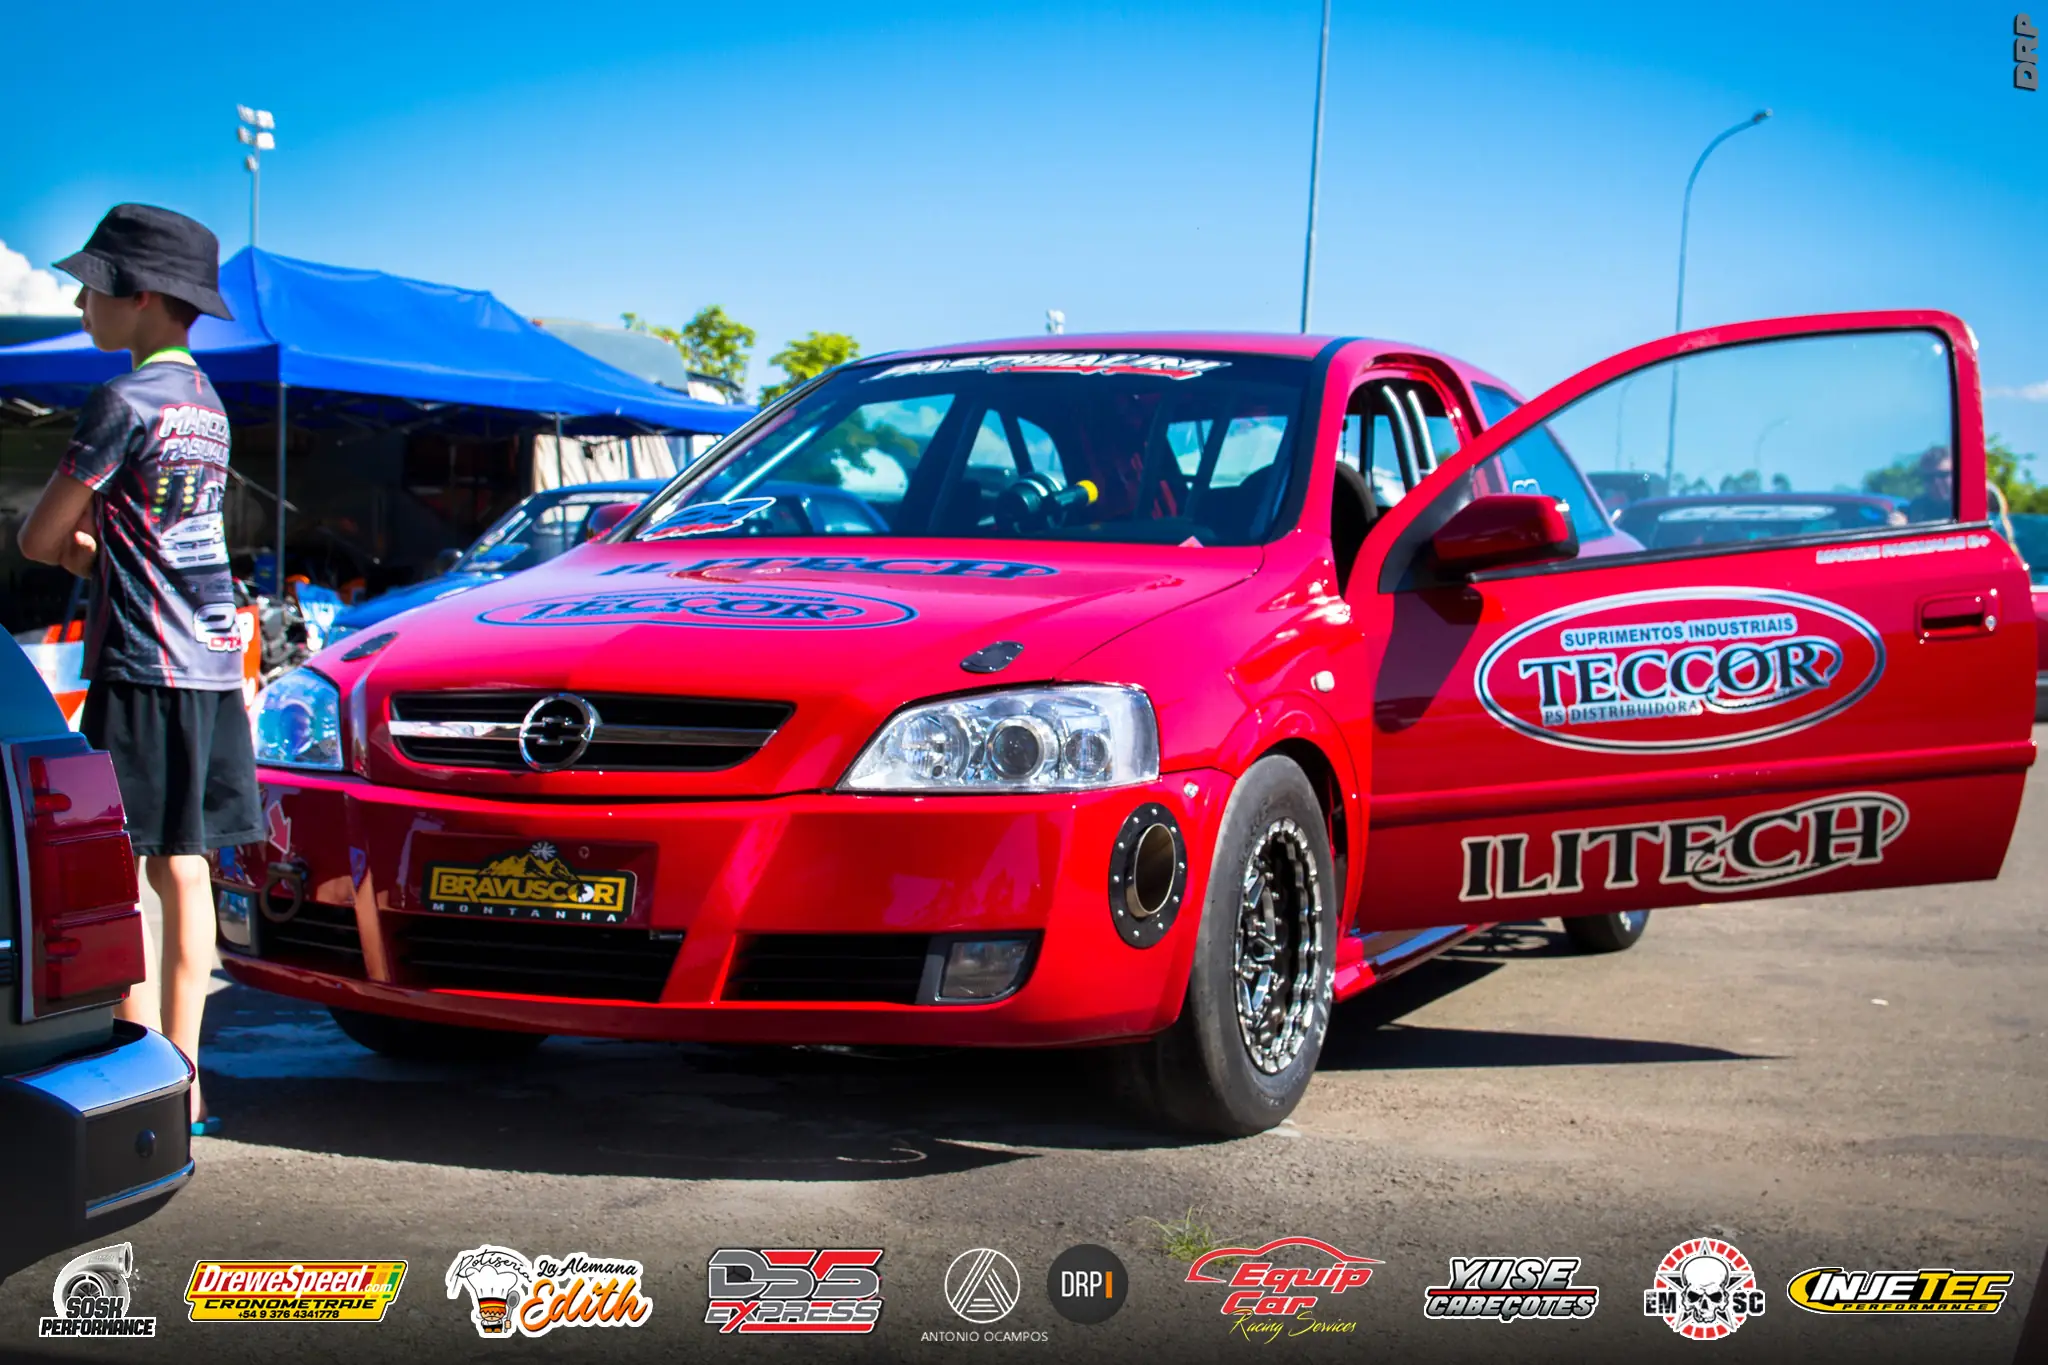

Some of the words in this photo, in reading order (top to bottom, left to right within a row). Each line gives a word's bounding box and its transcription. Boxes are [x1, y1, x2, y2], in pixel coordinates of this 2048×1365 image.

[598, 557, 1060, 581] ILITECH
[517, 597, 866, 621] TECCOR
[1564, 625, 1684, 648] SUPRIMENTOS
[1688, 616, 1794, 640] INDUSTRIAIS
[1521, 638, 1842, 711] TECCOR
[1570, 698, 1699, 723] DISTRIBUIDORA
[1460, 793, 1908, 901] ILITECH
[438, 873, 616, 905] BRAVUSCOR
[431, 901, 618, 923] MONTANHA
